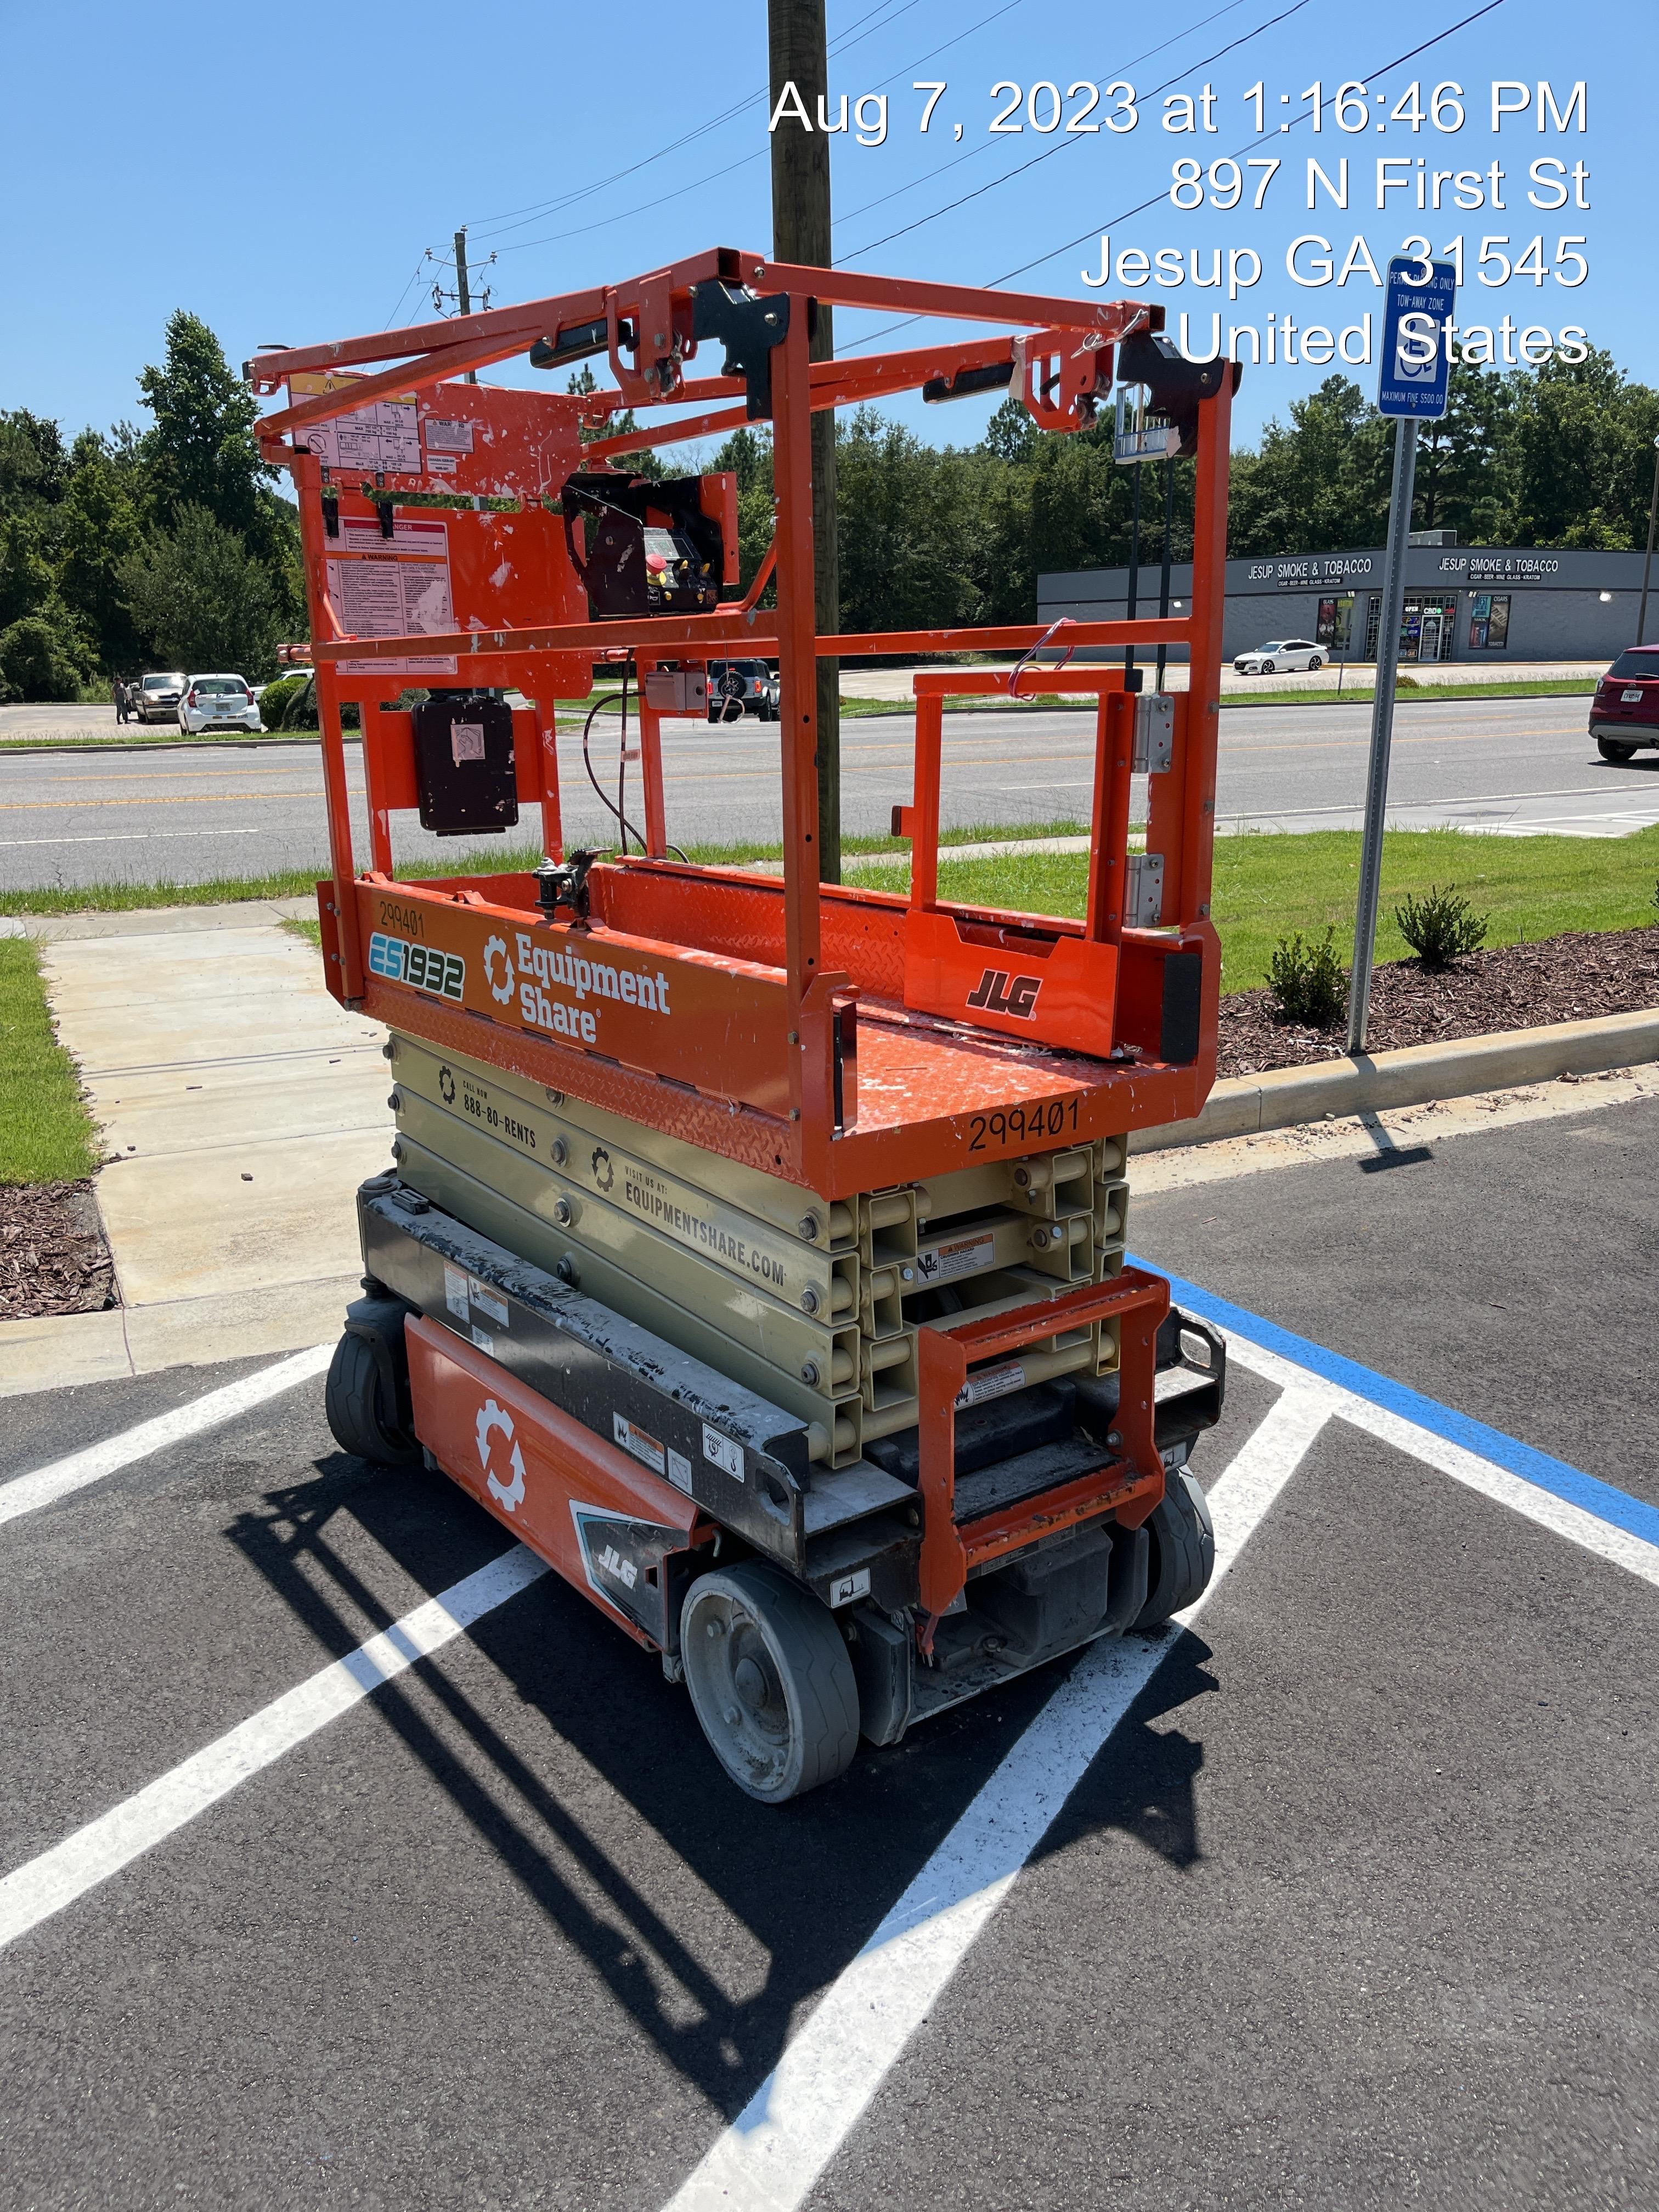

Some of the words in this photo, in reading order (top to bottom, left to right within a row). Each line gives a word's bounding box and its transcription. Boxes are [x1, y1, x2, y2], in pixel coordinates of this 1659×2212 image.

[1390, 272, 1412, 285] PER
[1440, 277, 1455, 291] ONLY
[1397, 294, 1427, 309] TOW-AWAY
[1428, 297, 1444, 311] ZONE
[1381, 391, 1406, 402] MAXIMUM
[1407, 392, 1419, 403] FINE
[1420, 393, 1443, 404] $500.00
[1248, 565, 1273, 579] JESUP
[1277, 562, 1308, 578] SMOKE
[1312, 562, 1319, 575] &
[1324, 558, 1372, 575] TOBACCO
[1439, 558, 1466, 571] JESUP
[1470, 558, 1502, 572] SMOKE
[1505, 559, 1511, 572] &
[1516, 560, 1559, 572] TOBACCO
[380, 901, 425, 938] 299401
[369, 932, 465, 1002] ES1932
[516, 933, 670, 1014] Equipment
[520, 983, 597, 1043] Share
[966, 968, 1043, 1020] JLG
[463, 1080, 475, 1093] CALL
[477, 1087, 488, 1099] NOW
[464, 1094, 536, 1148] 888-80-RENTS
[968, 1098, 1079, 1151] 299401
[625, 1165, 642, 1182] VISIT
[645, 1176, 654, 1188] US
[657, 1182, 668, 1195] AT:
[625, 1181, 784, 1286] EQUIPMENTSHARE.COM
[598, 1544, 637, 1589] JLG
